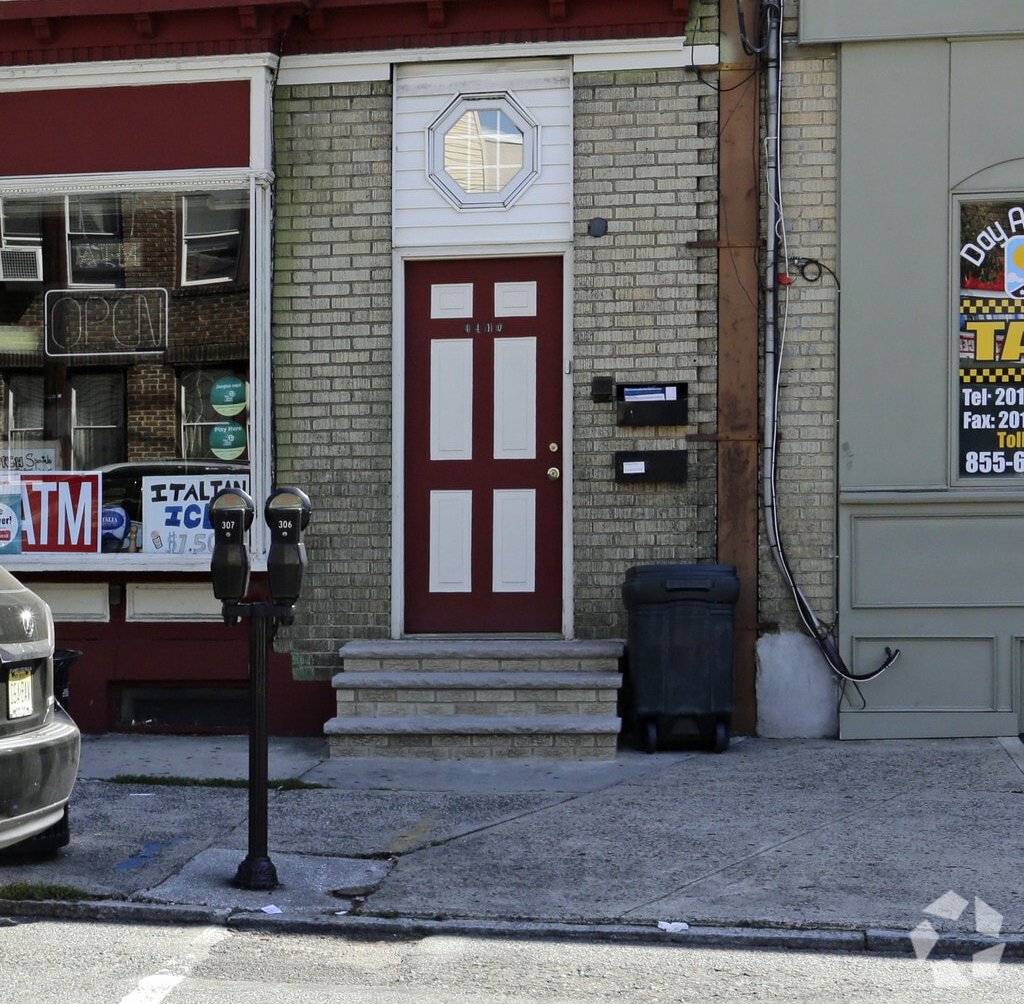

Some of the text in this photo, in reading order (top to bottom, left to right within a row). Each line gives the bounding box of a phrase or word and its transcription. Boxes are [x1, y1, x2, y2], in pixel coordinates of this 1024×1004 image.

[959, 220, 1008, 267] Day
[79, 243, 137, 269] ATM
[963, 411, 995, 429] Fax:
[965, 451, 1024, 474] 855-6
[20, 481, 92, 546] ATM
[221, 521, 235, 529] 307
[278, 520, 293, 529] 306
